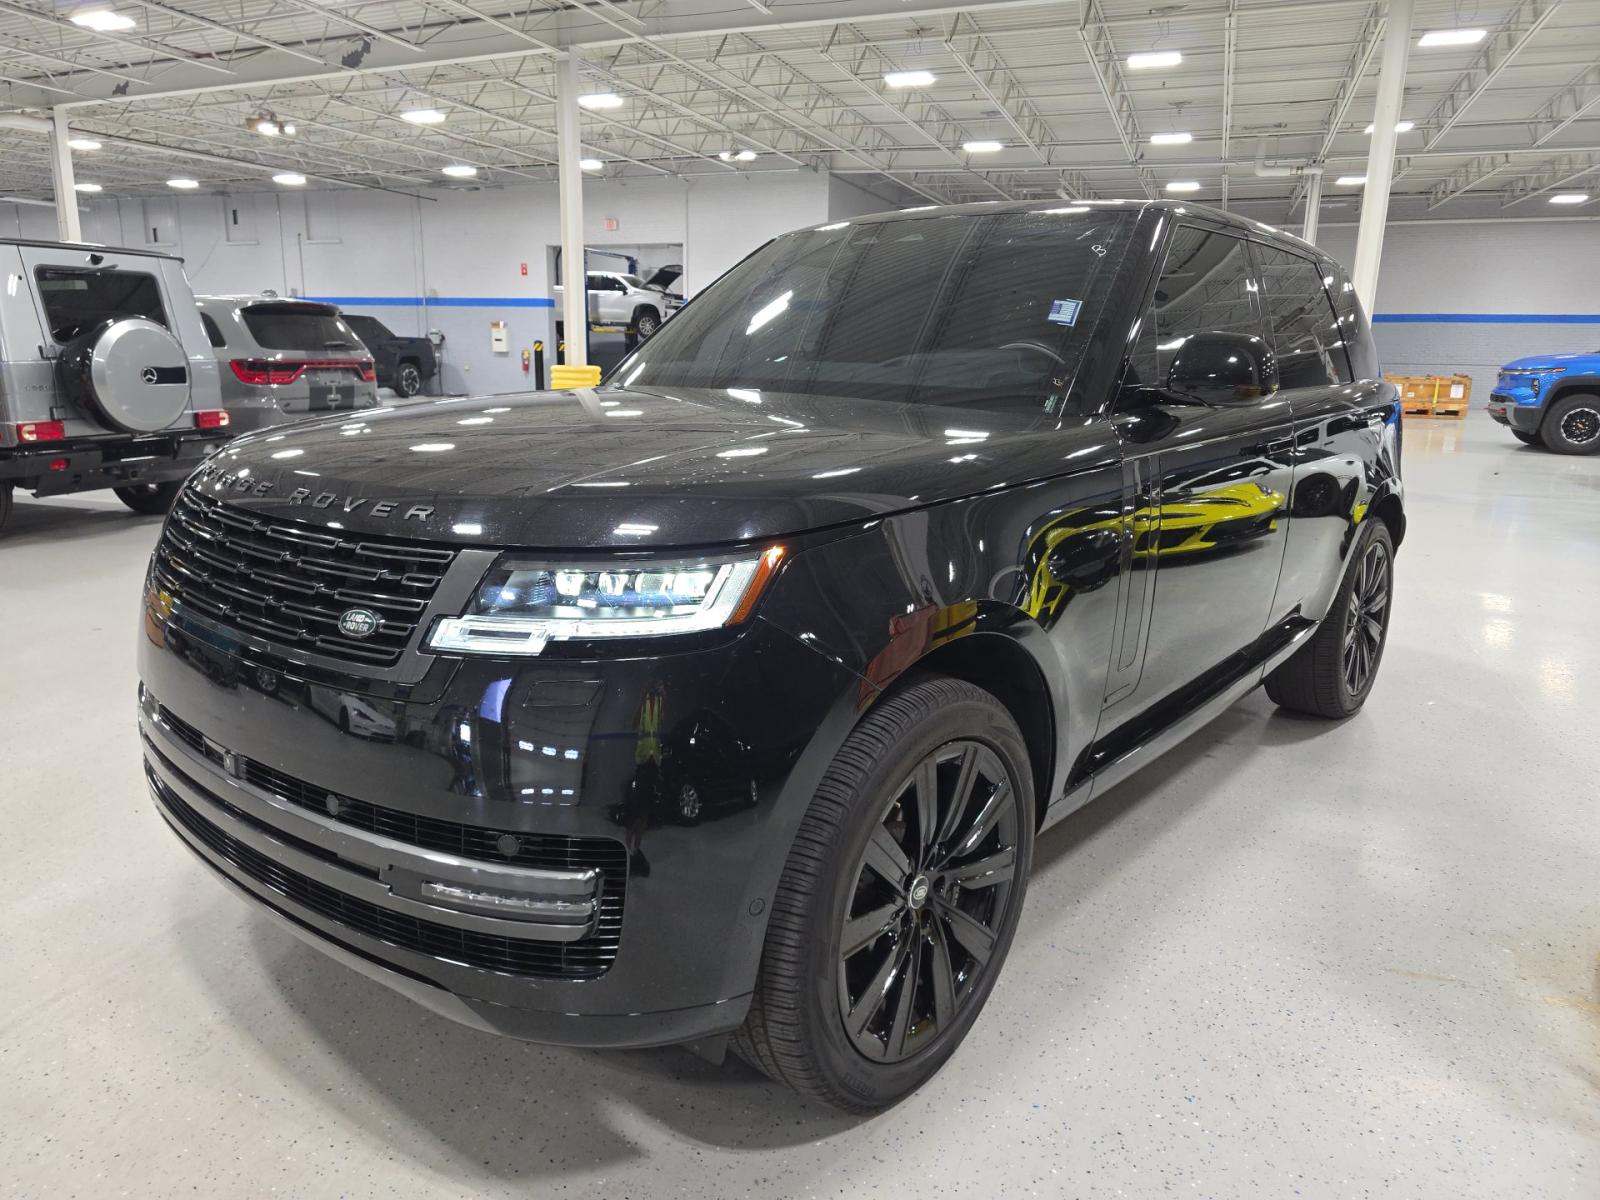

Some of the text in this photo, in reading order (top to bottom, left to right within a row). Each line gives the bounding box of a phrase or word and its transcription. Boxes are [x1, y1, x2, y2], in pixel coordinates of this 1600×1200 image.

[288, 487, 435, 522] ROVER
[345, 612, 366, 623] LAND
[345, 621, 369, 632] ROVER
